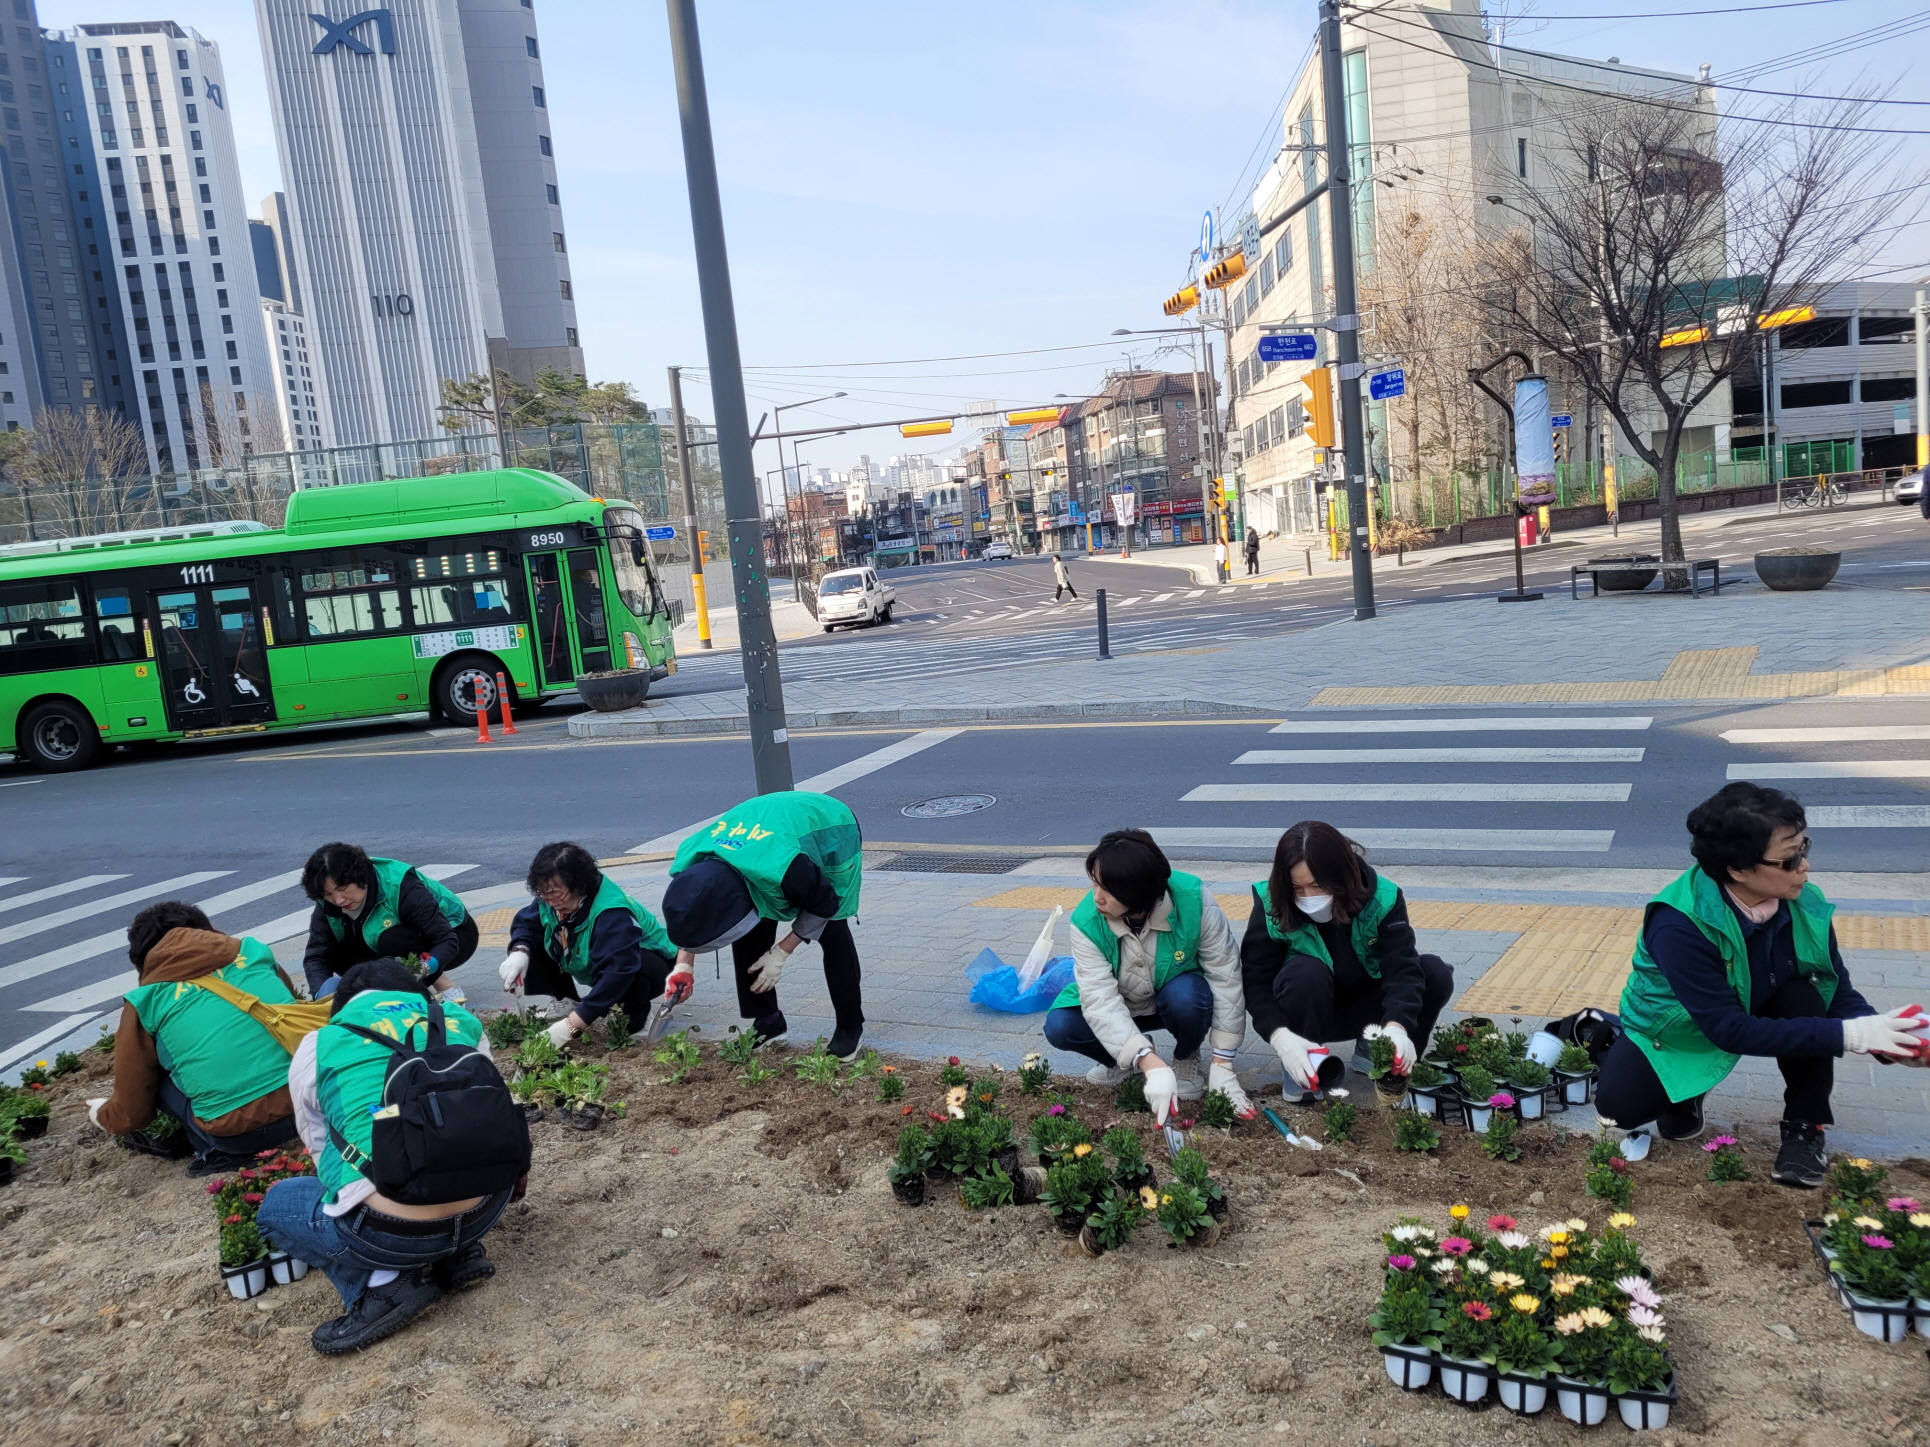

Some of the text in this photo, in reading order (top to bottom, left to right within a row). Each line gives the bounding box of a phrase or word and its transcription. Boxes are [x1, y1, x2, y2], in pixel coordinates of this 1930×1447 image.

[372, 294, 416, 318] 110
[531, 532, 564, 547] 8950
[180, 564, 214, 585] 1111
[456, 634, 473, 643] 1111
